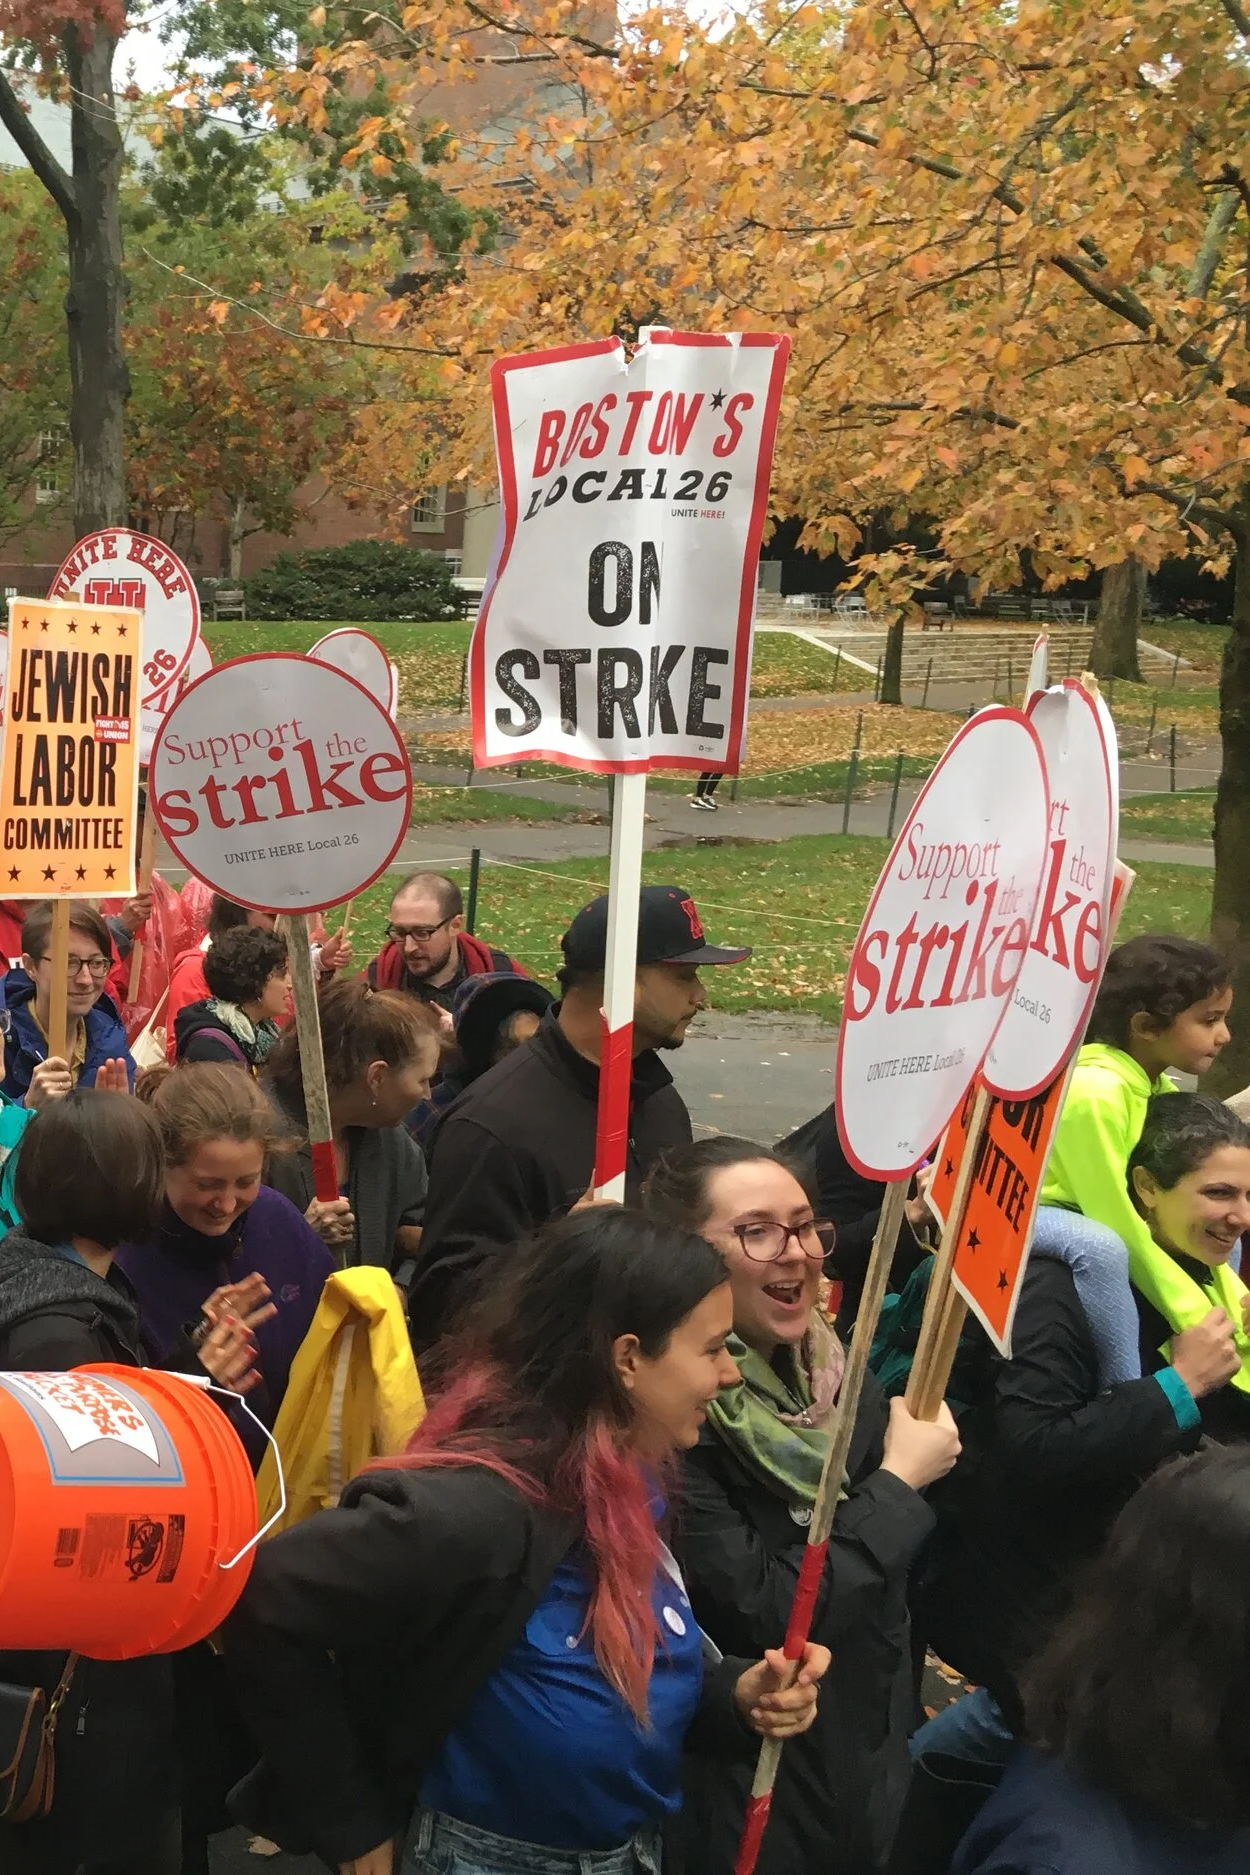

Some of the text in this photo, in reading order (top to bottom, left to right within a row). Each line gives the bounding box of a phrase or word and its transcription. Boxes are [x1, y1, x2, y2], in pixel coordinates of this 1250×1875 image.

[671, 509, 725, 519] UNITE HERE!
[53, 535, 186, 600] UNITE HERE
[12, 649, 132, 723] JEWISH
[143, 648, 177, 688] 26
[104, 730, 128, 740] UNION
[164, 717, 306, 769] Support
[325, 733, 368, 758] the
[13, 733, 116, 808] LABOR
[158, 739, 407, 837] strike
[4, 818, 123, 850] COMMITTEE
[225, 833, 359, 865] UNITE HERE Local 26
[899, 822, 1001, 900] Support
[1070, 846, 1096, 891] the
[998, 876, 1024, 917] the
[846, 878, 1031, 1022] strike
[1039, 1008, 1052, 1024] 26
[867, 1059, 899, 1082] UNITE
[899, 1055, 932, 1075] HERE
